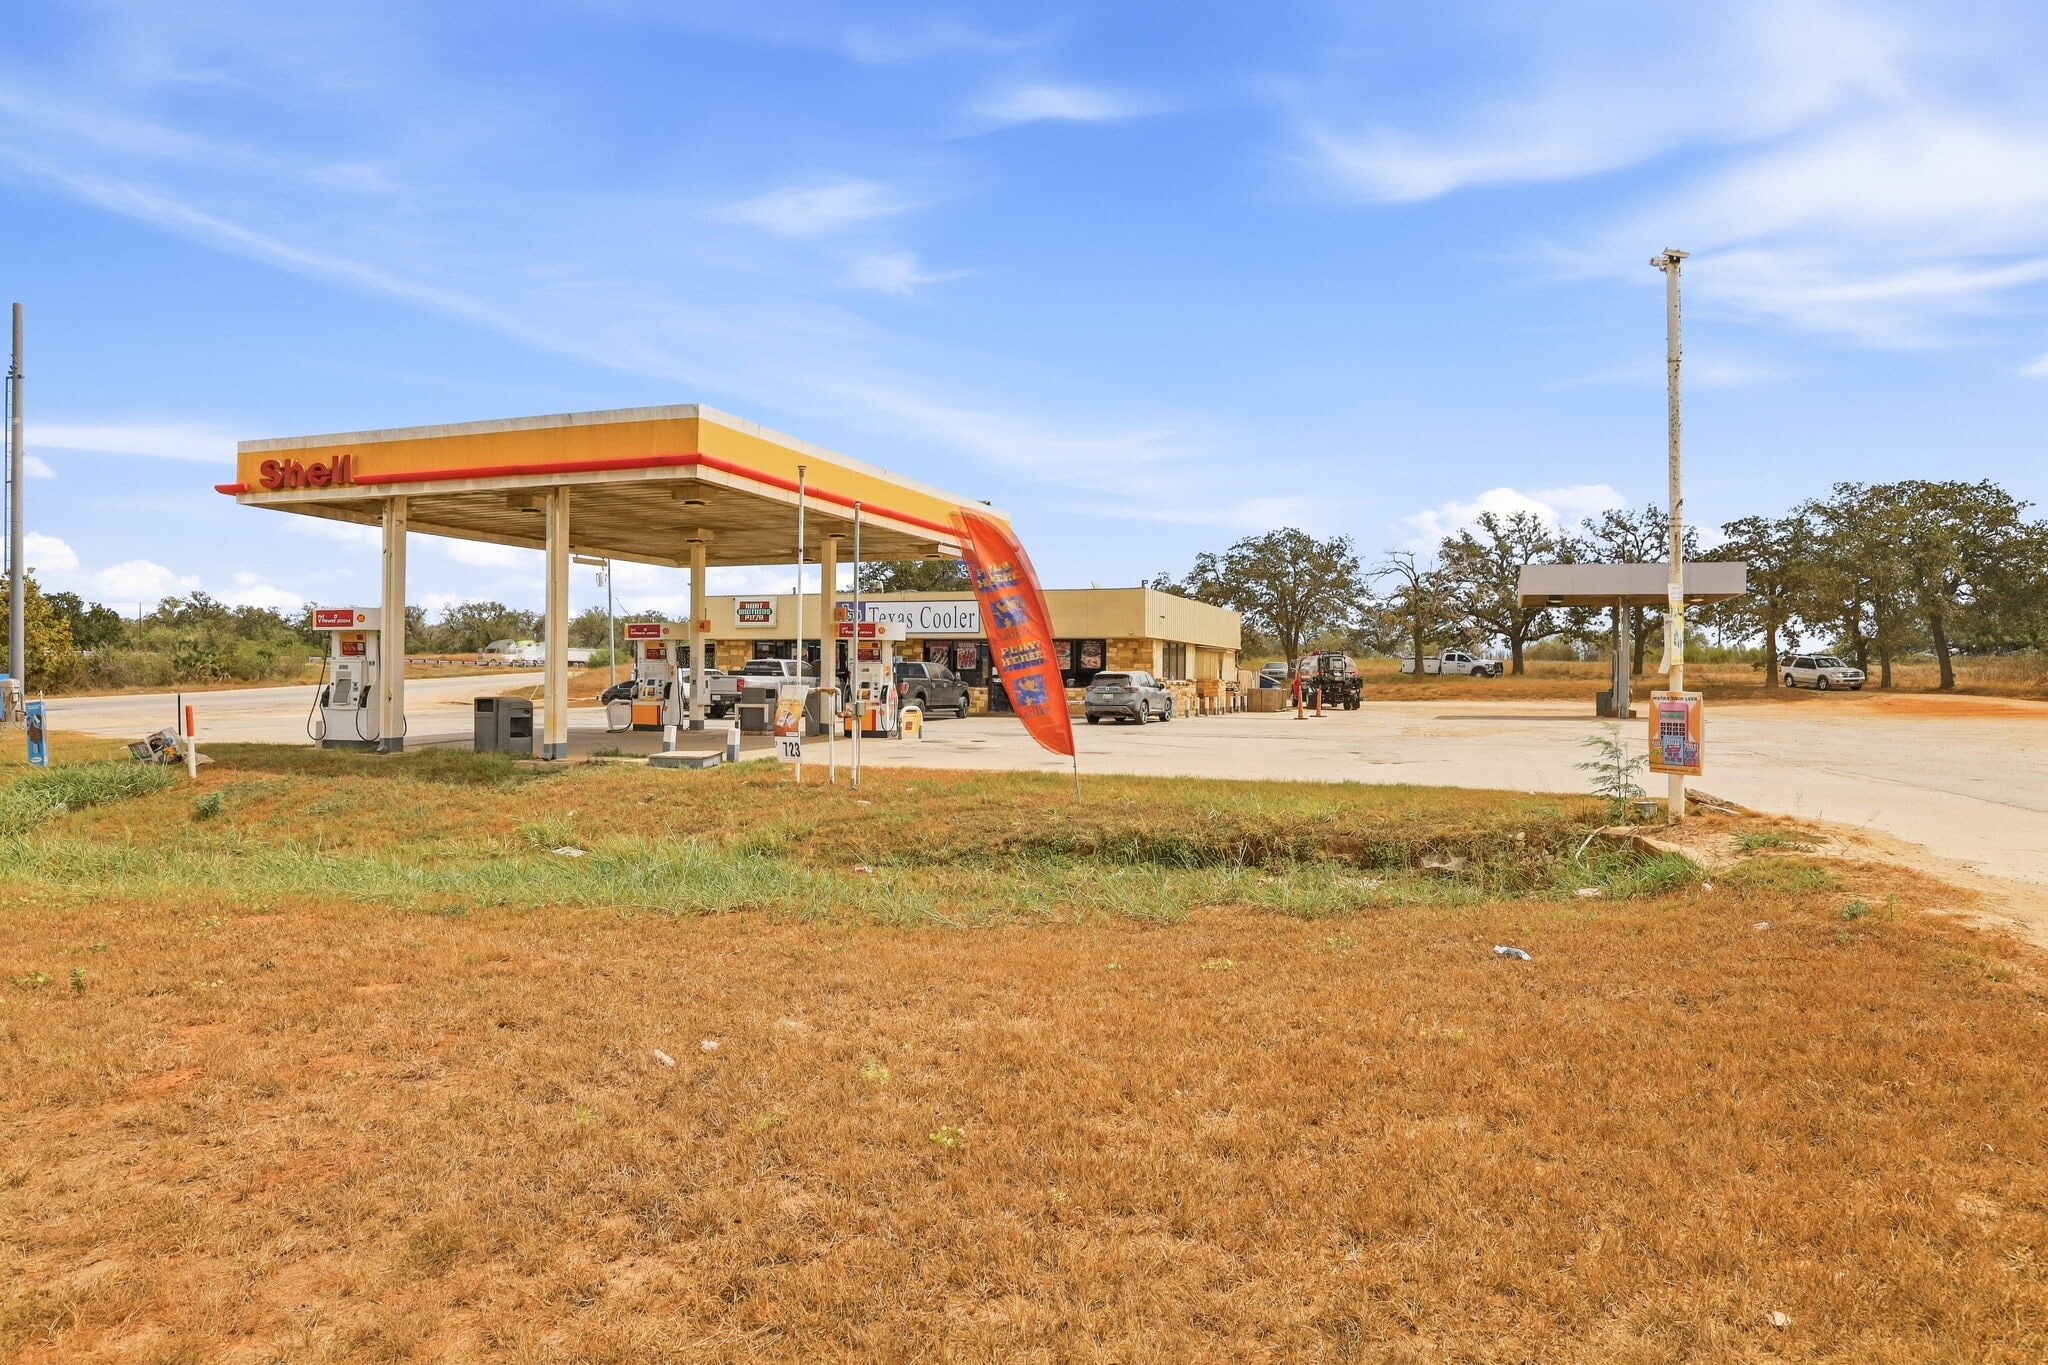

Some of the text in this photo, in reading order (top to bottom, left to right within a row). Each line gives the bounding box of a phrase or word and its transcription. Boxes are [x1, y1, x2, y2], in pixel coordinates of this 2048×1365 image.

[259, 454, 353, 489] Shell
[920, 605, 975, 629] Cooler
[782, 741, 801, 758] 723
